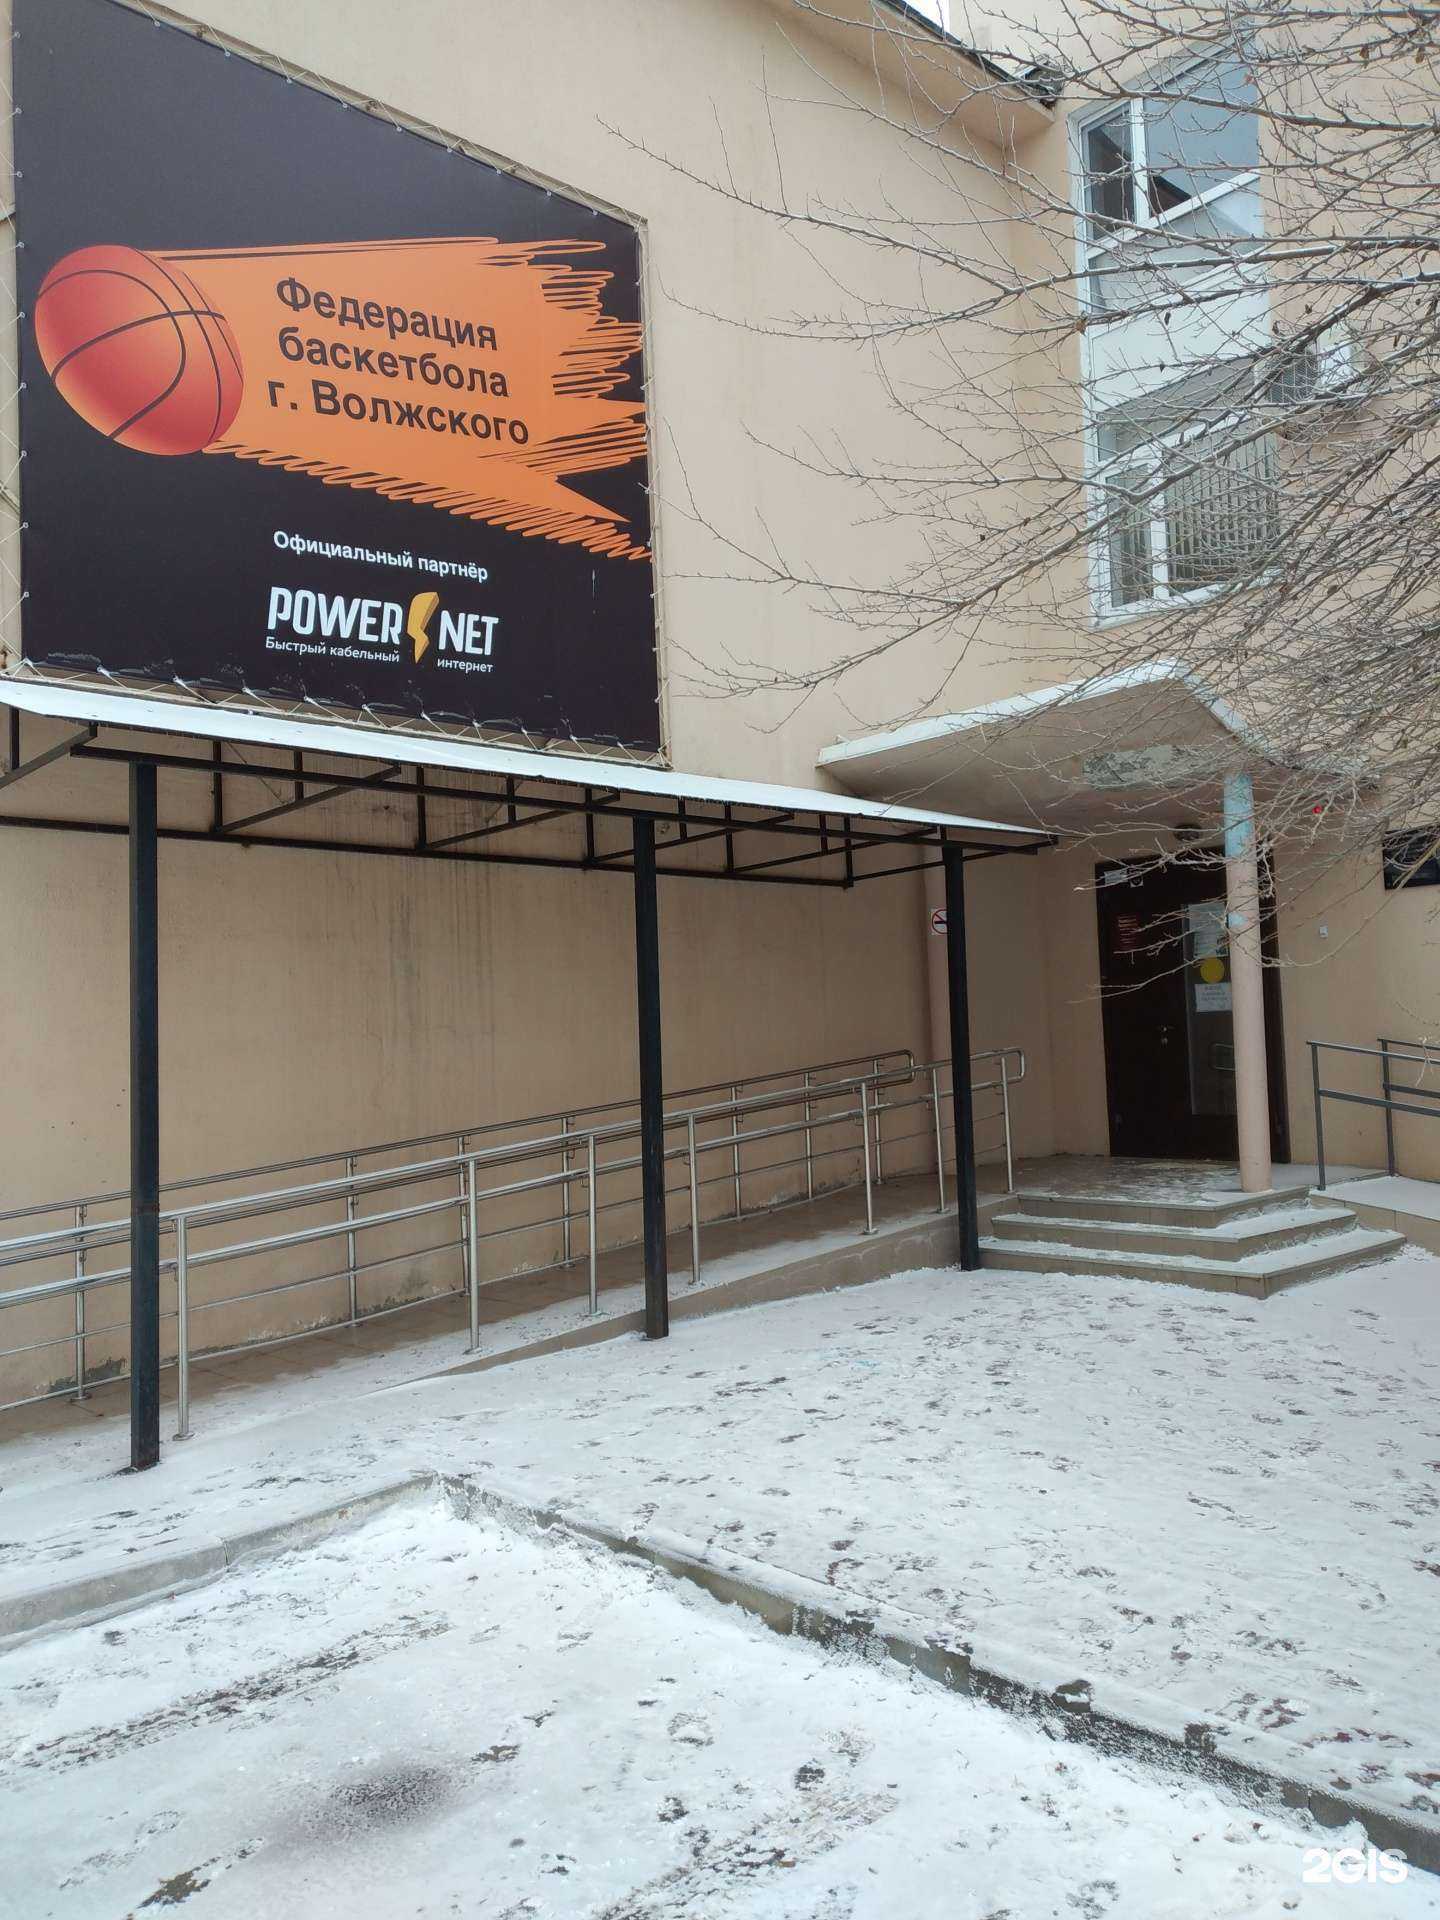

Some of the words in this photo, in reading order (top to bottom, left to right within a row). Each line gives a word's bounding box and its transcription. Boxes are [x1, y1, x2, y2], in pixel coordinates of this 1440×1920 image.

[276, 277, 498, 351] Федерация
[278, 326, 510, 398] баскетбола
[267, 380, 298, 410] г.
[311, 379, 529, 445] Волжского
[273, 530, 414, 569] Официальный
[418, 557, 489, 584] партнёр
[265, 636, 327, 657] Быстрый
[330, 645, 400, 663] кабельный
[437, 658, 494, 674] интернет
[267, 586, 403, 645] POWER
[438, 610, 499, 656] NET
